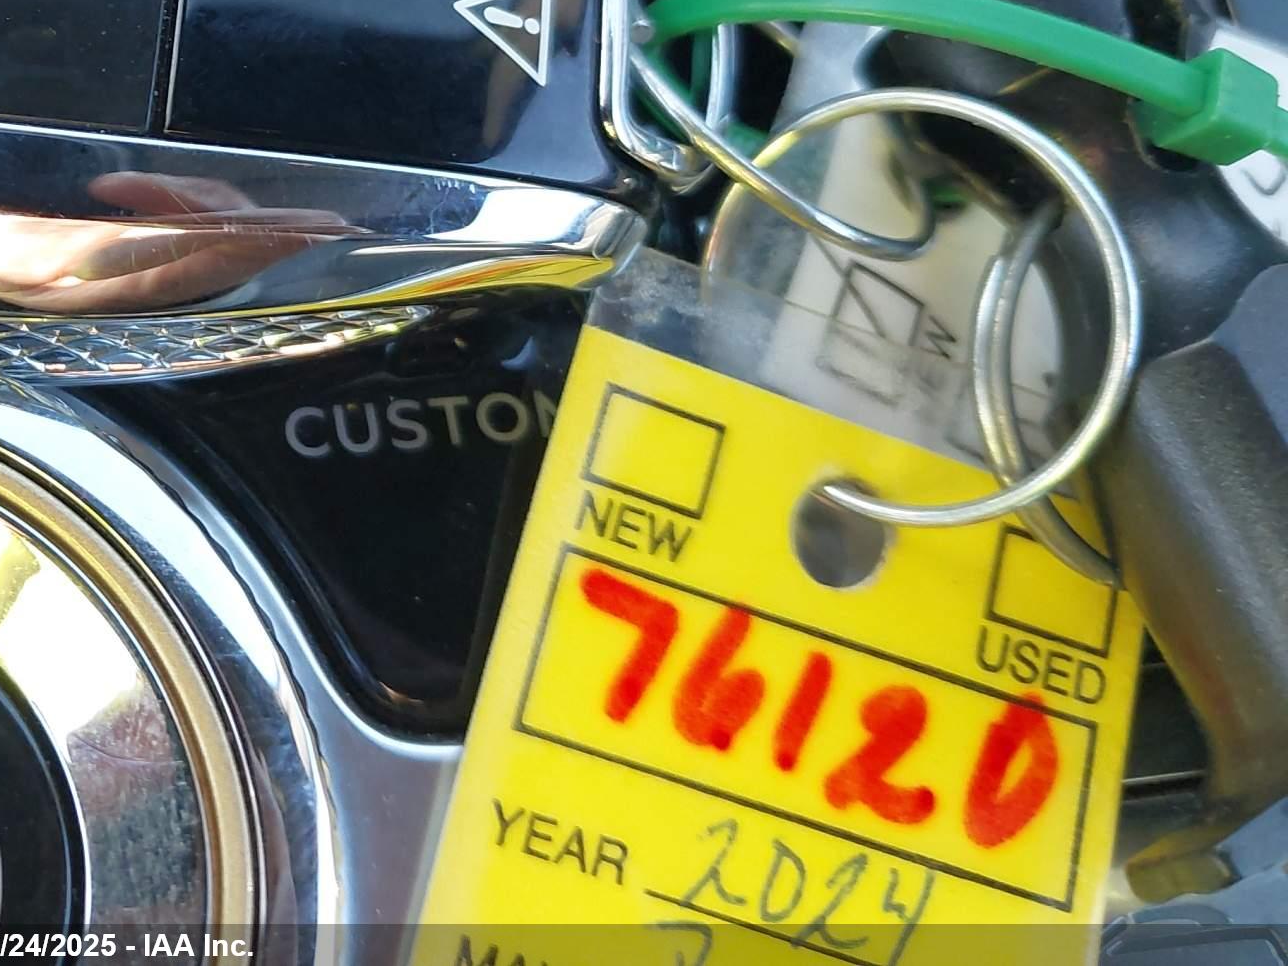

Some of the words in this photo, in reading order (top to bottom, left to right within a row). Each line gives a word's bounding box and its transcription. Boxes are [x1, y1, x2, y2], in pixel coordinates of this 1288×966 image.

[576, 490, 694, 564] NEW
[580, 567, 1059, 851] 76120
[975, 629, 1108, 708] USED
[491, 798, 629, 886] YEAR
[680, 817, 936, 966] 2024
